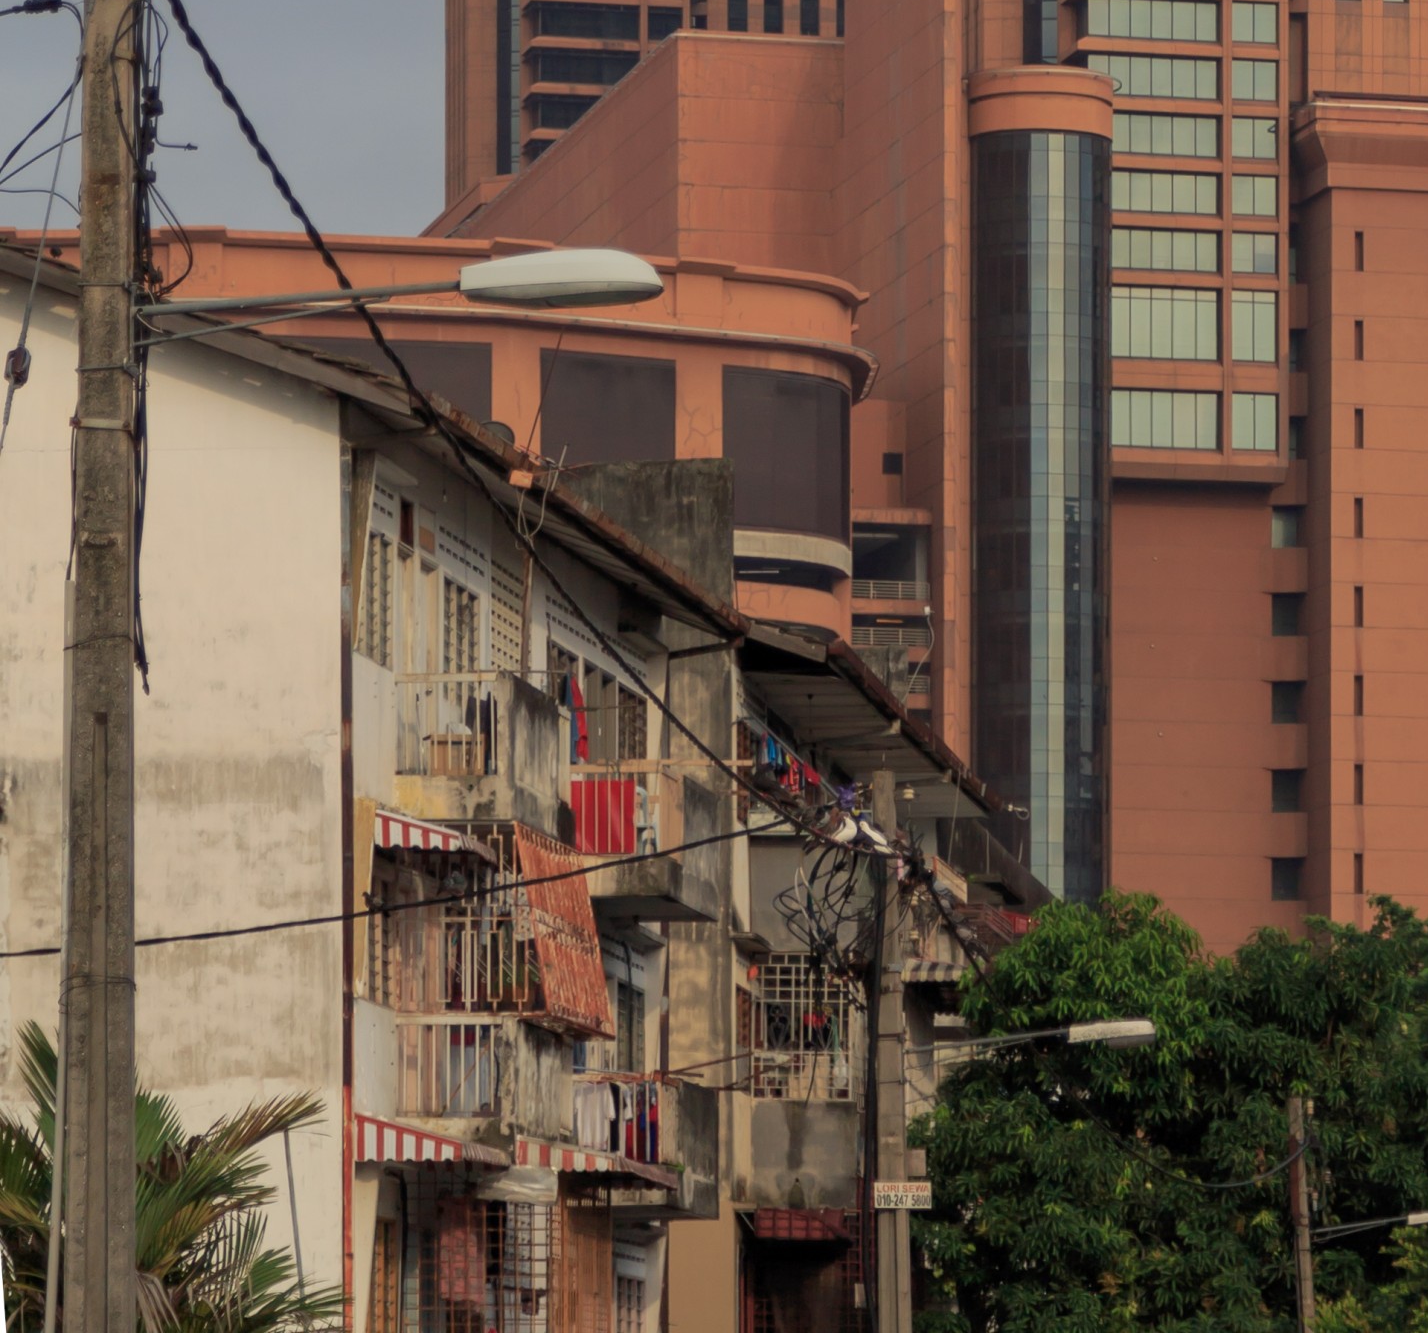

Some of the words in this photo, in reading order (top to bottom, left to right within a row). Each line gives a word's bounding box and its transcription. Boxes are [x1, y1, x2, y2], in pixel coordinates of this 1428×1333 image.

[876, 1184, 900, 1193] LORI
[902, 1184, 929, 1193] SEWA
[876, 1194, 909, 1207] 010-247
